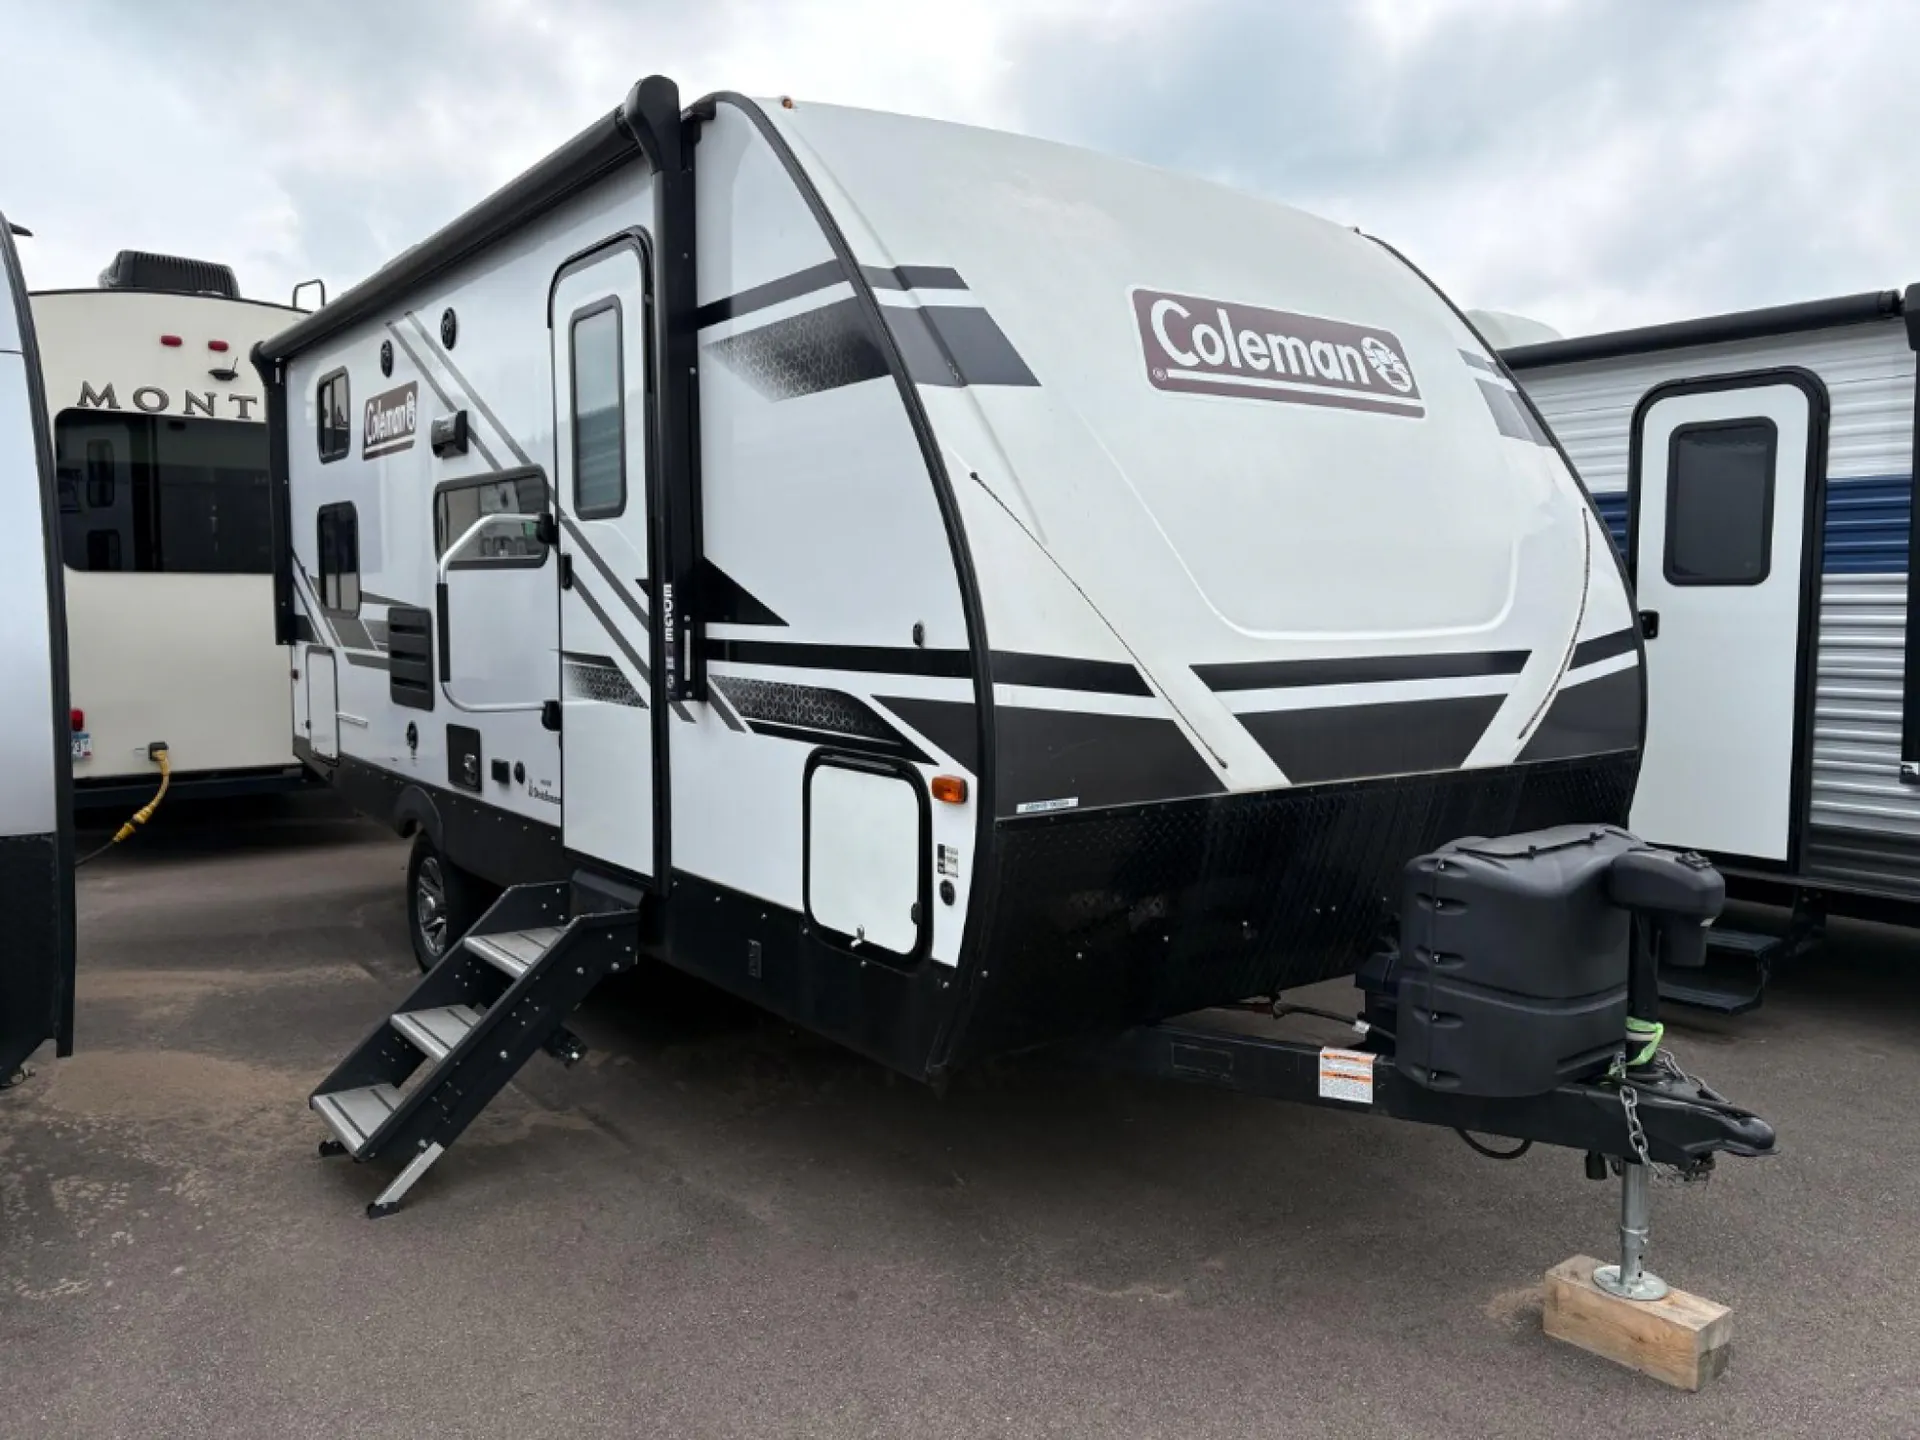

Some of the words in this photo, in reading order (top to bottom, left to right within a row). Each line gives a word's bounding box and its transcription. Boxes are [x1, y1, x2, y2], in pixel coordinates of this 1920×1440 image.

[1151, 300, 1371, 385] Coleman
[77, 380, 258, 420] MONT
[366, 399, 406, 445] Coleman
